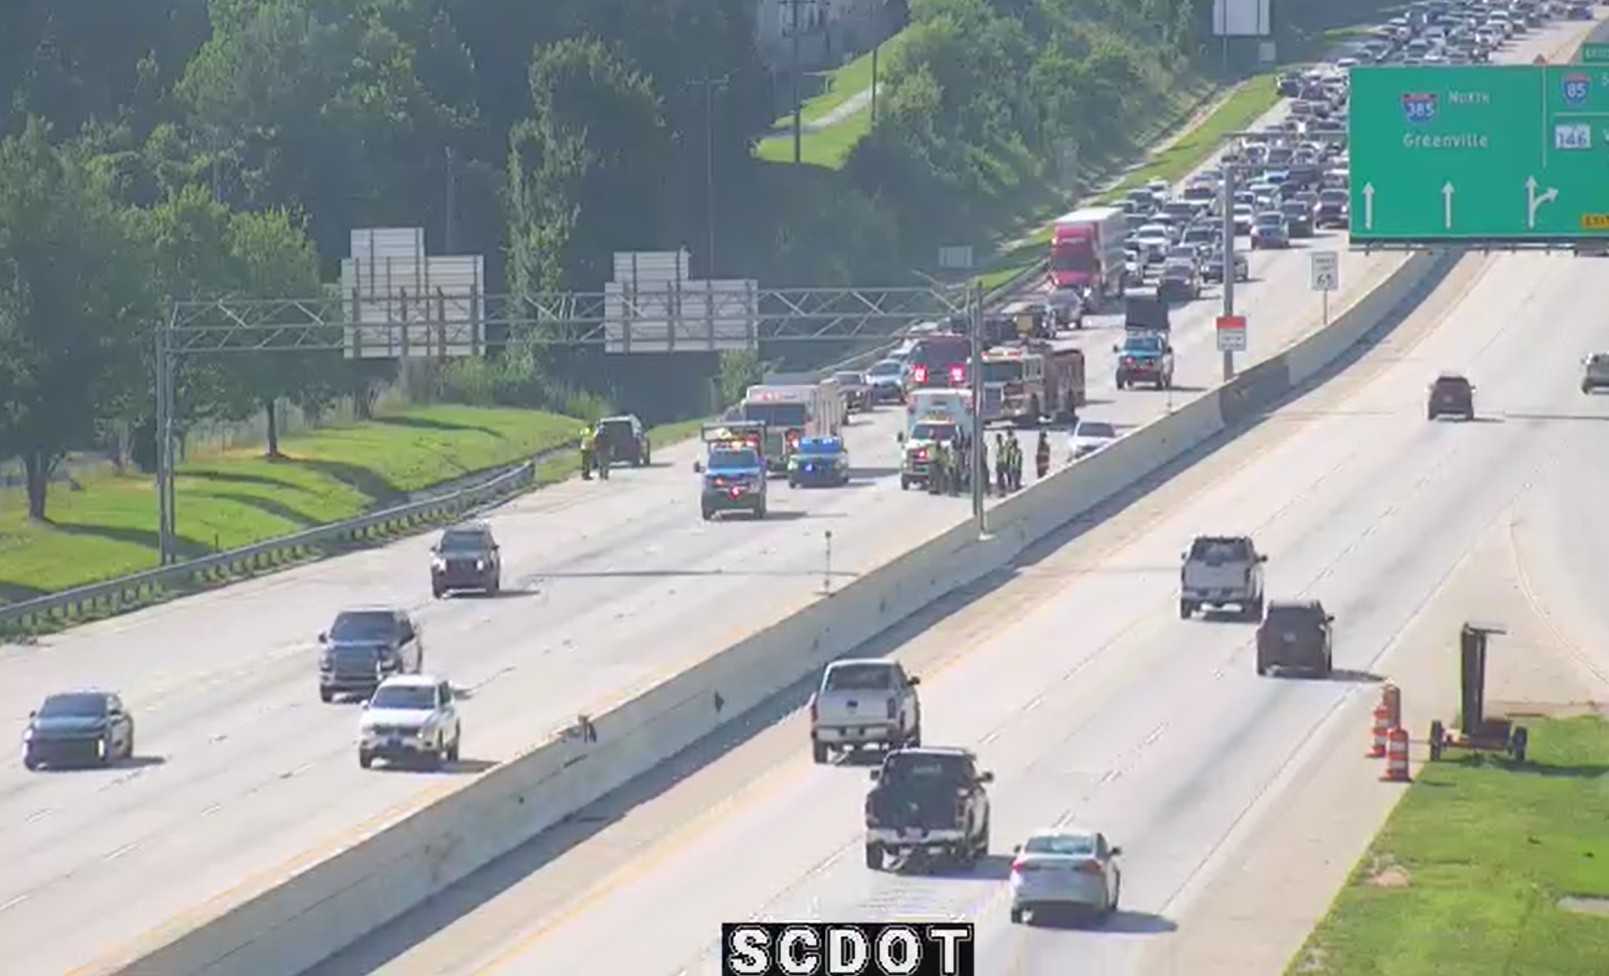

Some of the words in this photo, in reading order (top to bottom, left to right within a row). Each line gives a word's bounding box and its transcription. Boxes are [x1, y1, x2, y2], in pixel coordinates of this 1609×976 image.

[1567, 82, 1587, 99] 85
[1407, 102, 1435, 117] 385
[1403, 132, 1489, 148] Greenville
[1558, 129, 1587, 147] 146
